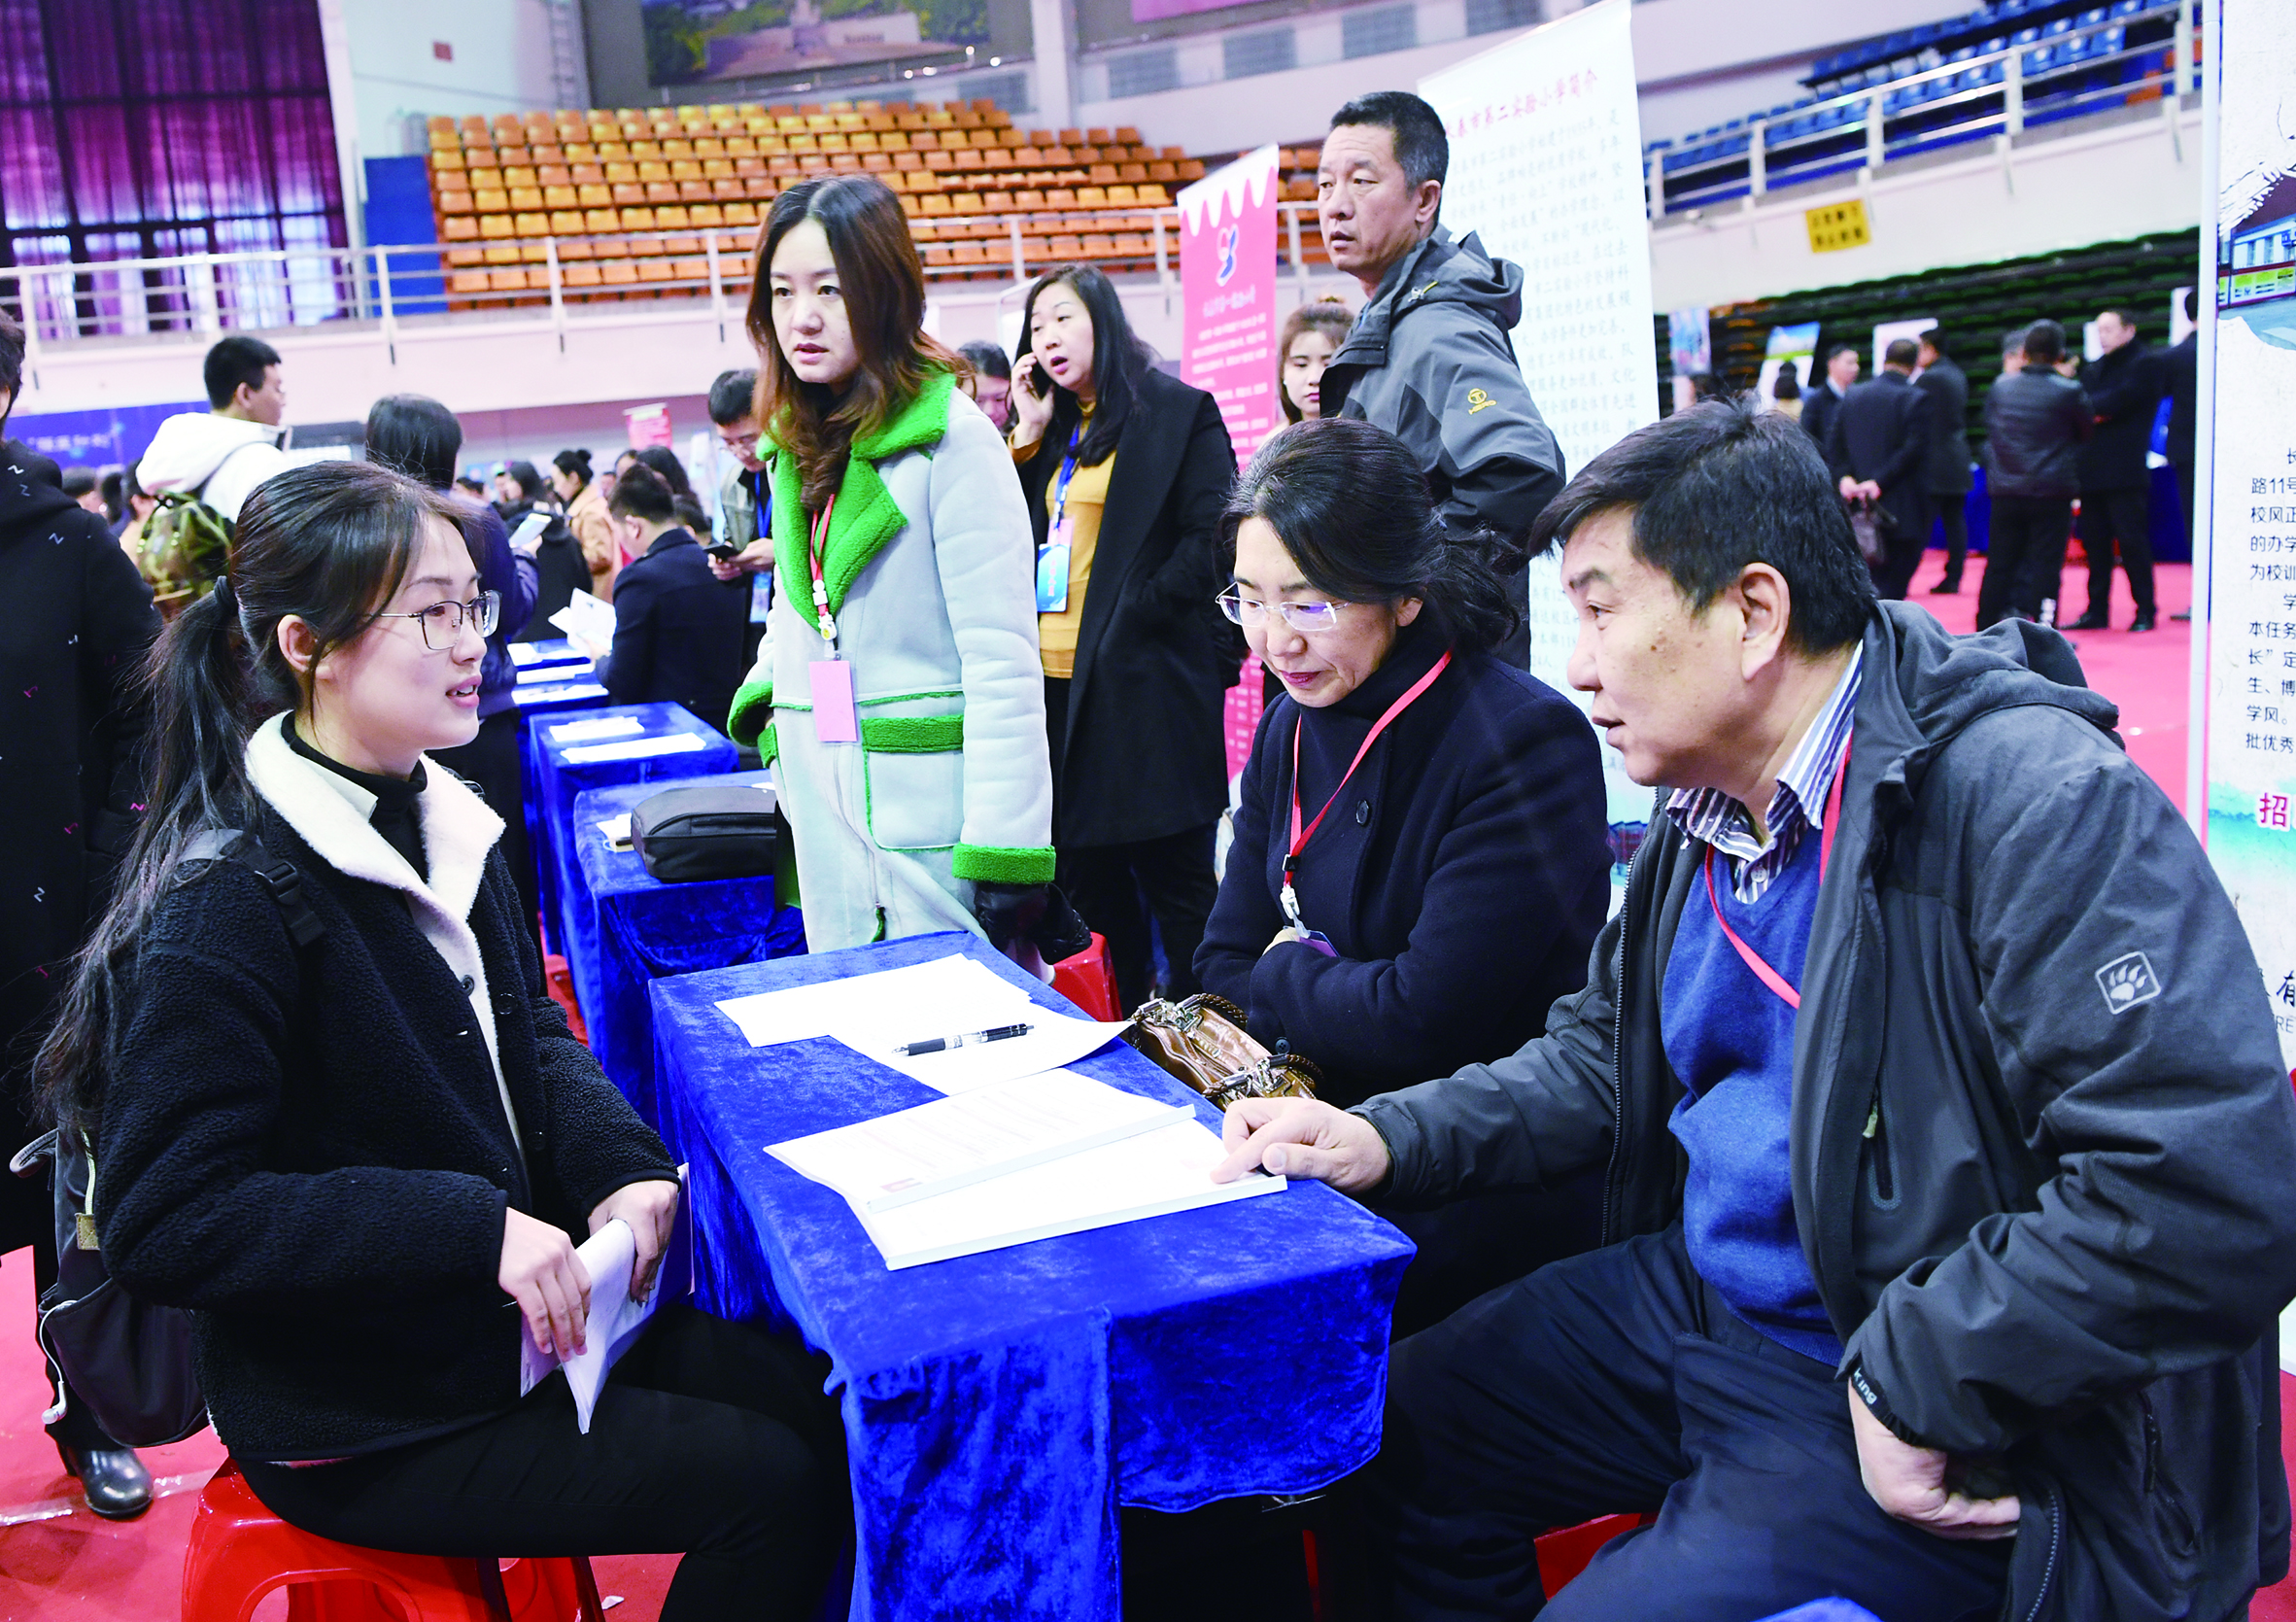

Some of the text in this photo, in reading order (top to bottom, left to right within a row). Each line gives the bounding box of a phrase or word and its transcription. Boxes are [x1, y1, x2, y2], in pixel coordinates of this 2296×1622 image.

[2249, 535, 2296, 553] 的办学
[2249, 564, 2296, 581] 为校训
[2283, 593, 2296, 611] 学
[2248, 620, 2296, 639] 本任务
[2246, 704, 2288, 725] 学风。
[2245, 733, 2295, 754] 批优秀
